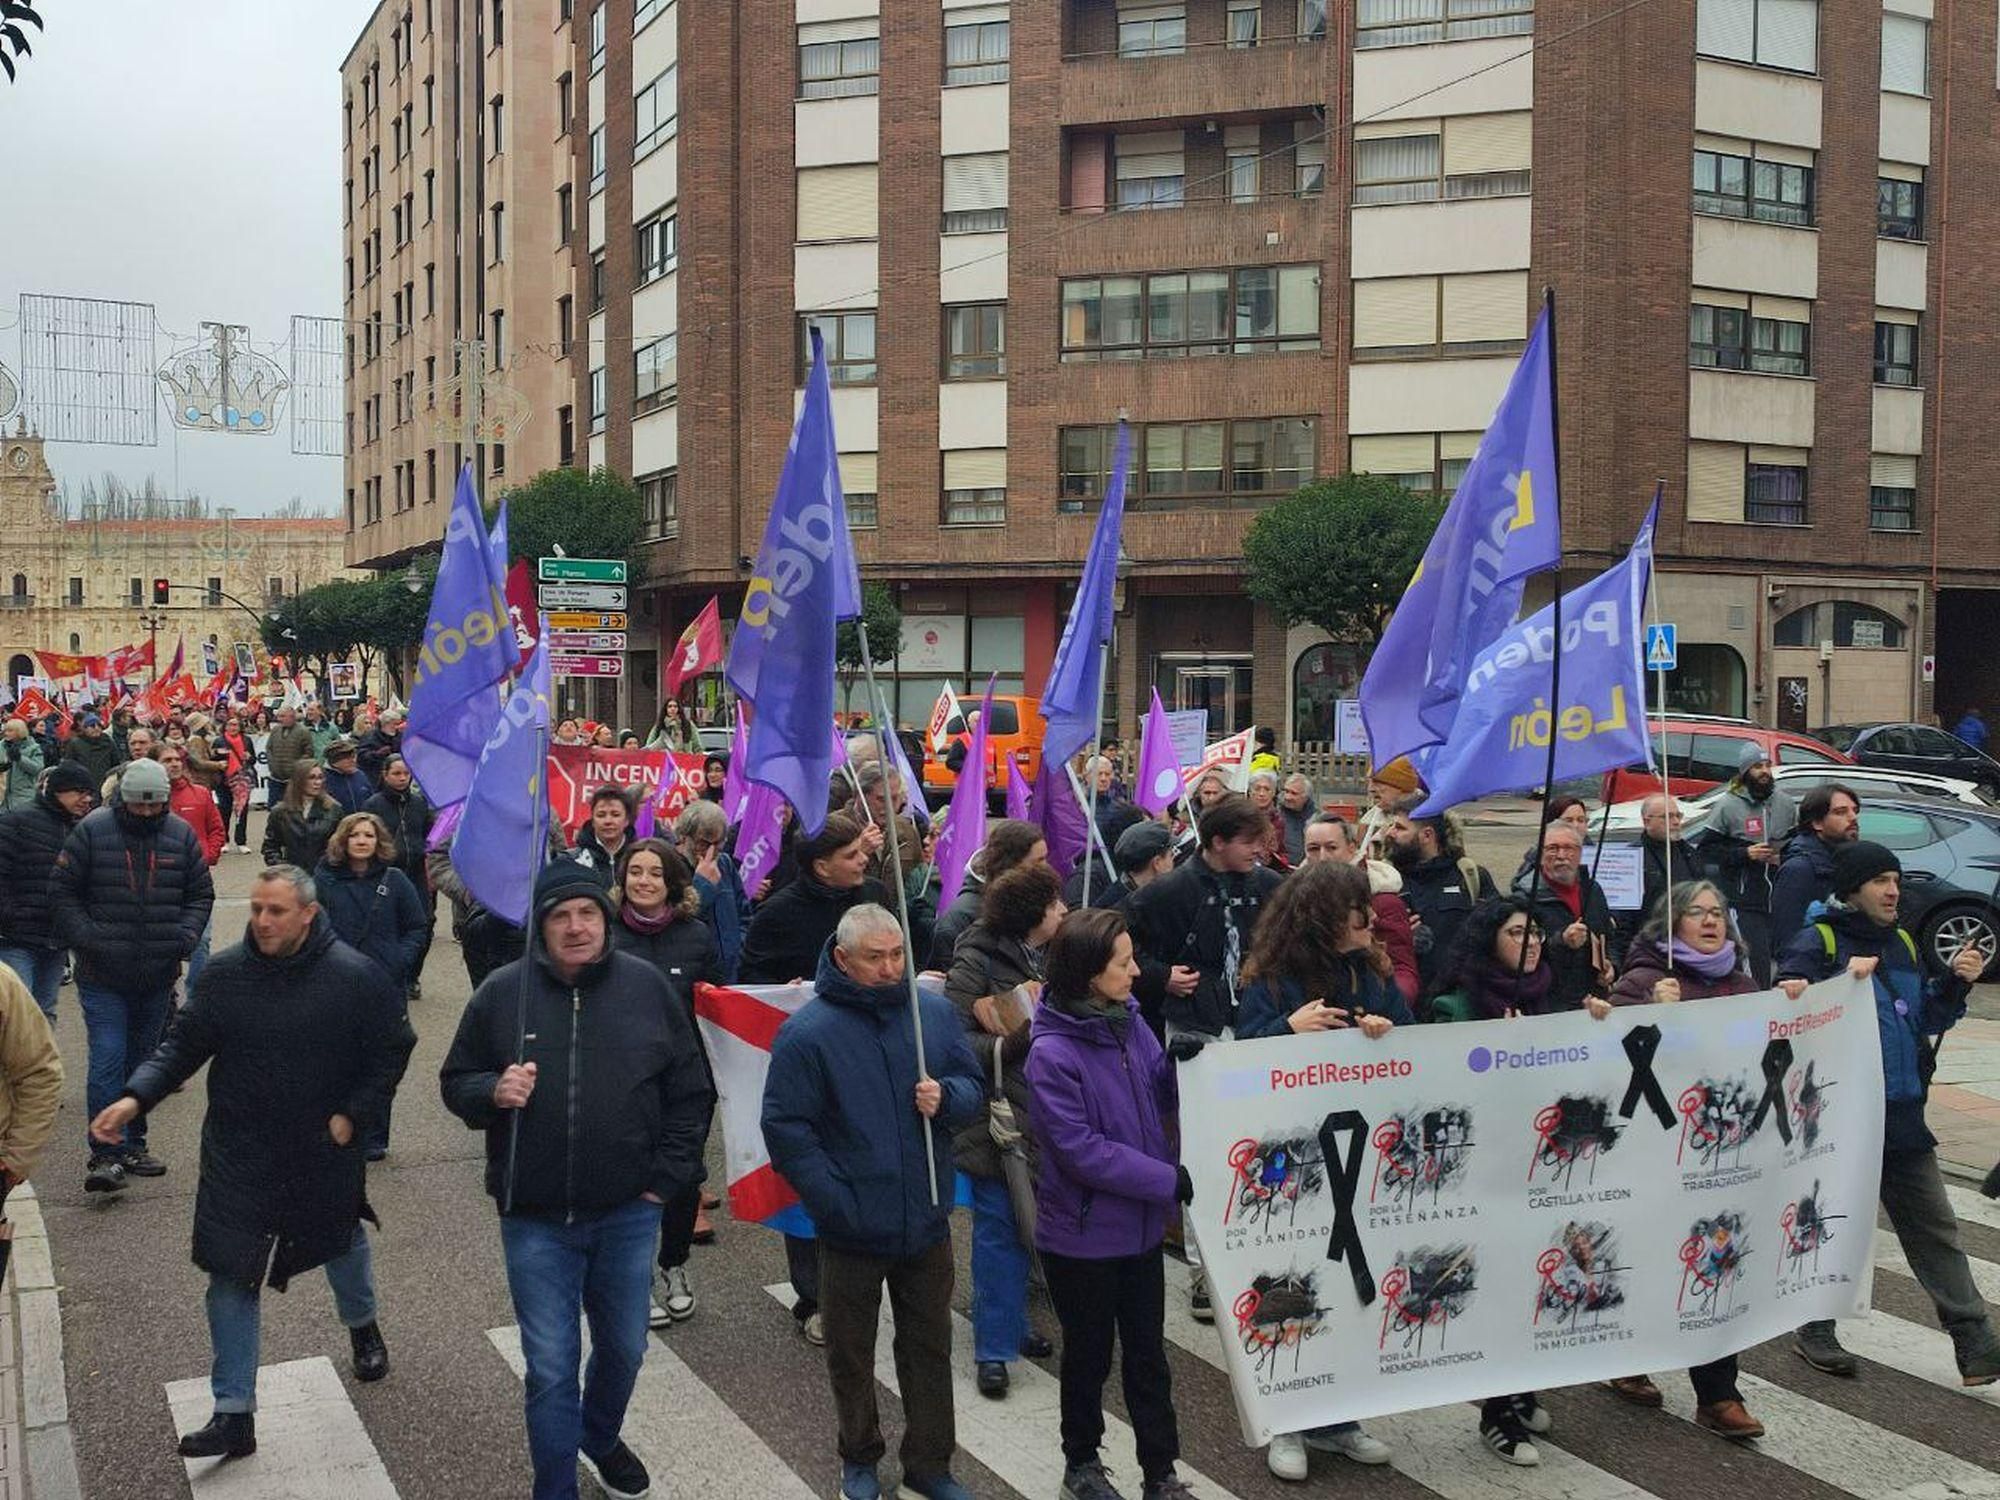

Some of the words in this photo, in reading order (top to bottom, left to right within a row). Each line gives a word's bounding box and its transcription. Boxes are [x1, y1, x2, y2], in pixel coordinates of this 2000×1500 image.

[1495, 1045, 1590, 1070] Podemos
[1271, 1058, 1413, 1090] PorElRespeto
[1528, 1187, 1547, 1196] POR
[1529, 1194, 1585, 1209] CASTILLA
[1587, 1191, 1597, 1202] Y
[1370, 1205, 1389, 1216] POR
[1391, 1203, 1404, 1213] LA
[1225, 1239, 1245, 1251] LA
[1254, 1225, 1330, 1247] SANIDAD
[1226, 1228, 1247, 1238] POR
[1533, 1329, 1634, 1351] INMIGRANTES
[1379, 1353, 1399, 1363] POR
[1401, 1351, 1414, 1360] LA
[1379, 1359, 1430, 1375] MEMORIA
[1273, 1373, 1336, 1394] AMBIENTE
